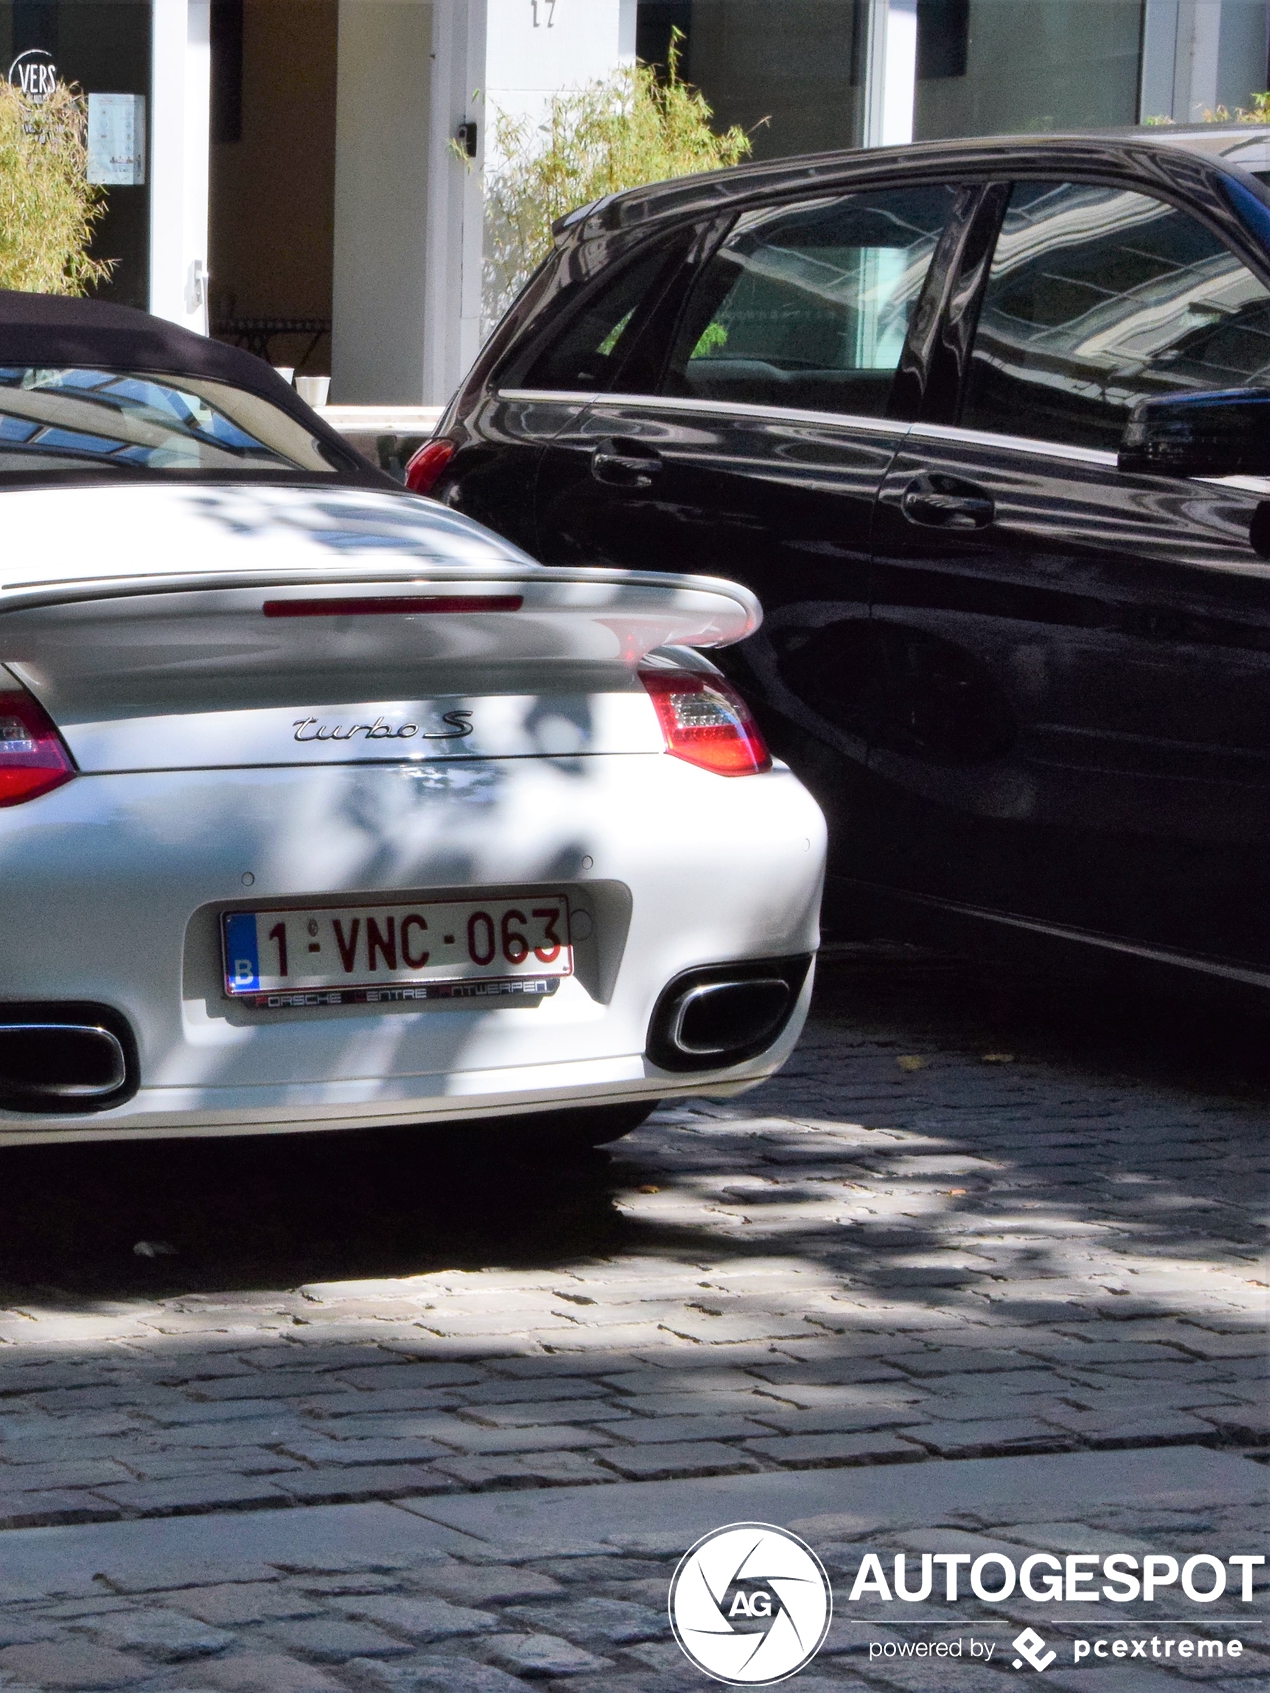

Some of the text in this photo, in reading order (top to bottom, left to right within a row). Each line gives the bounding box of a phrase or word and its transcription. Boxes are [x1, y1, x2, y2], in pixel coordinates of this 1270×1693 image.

[18, 64, 56, 93] VERS
[293, 710, 474, 742] turbo S
[234, 958, 255, 985] B
[255, 992, 341, 1007] PORSCHE
